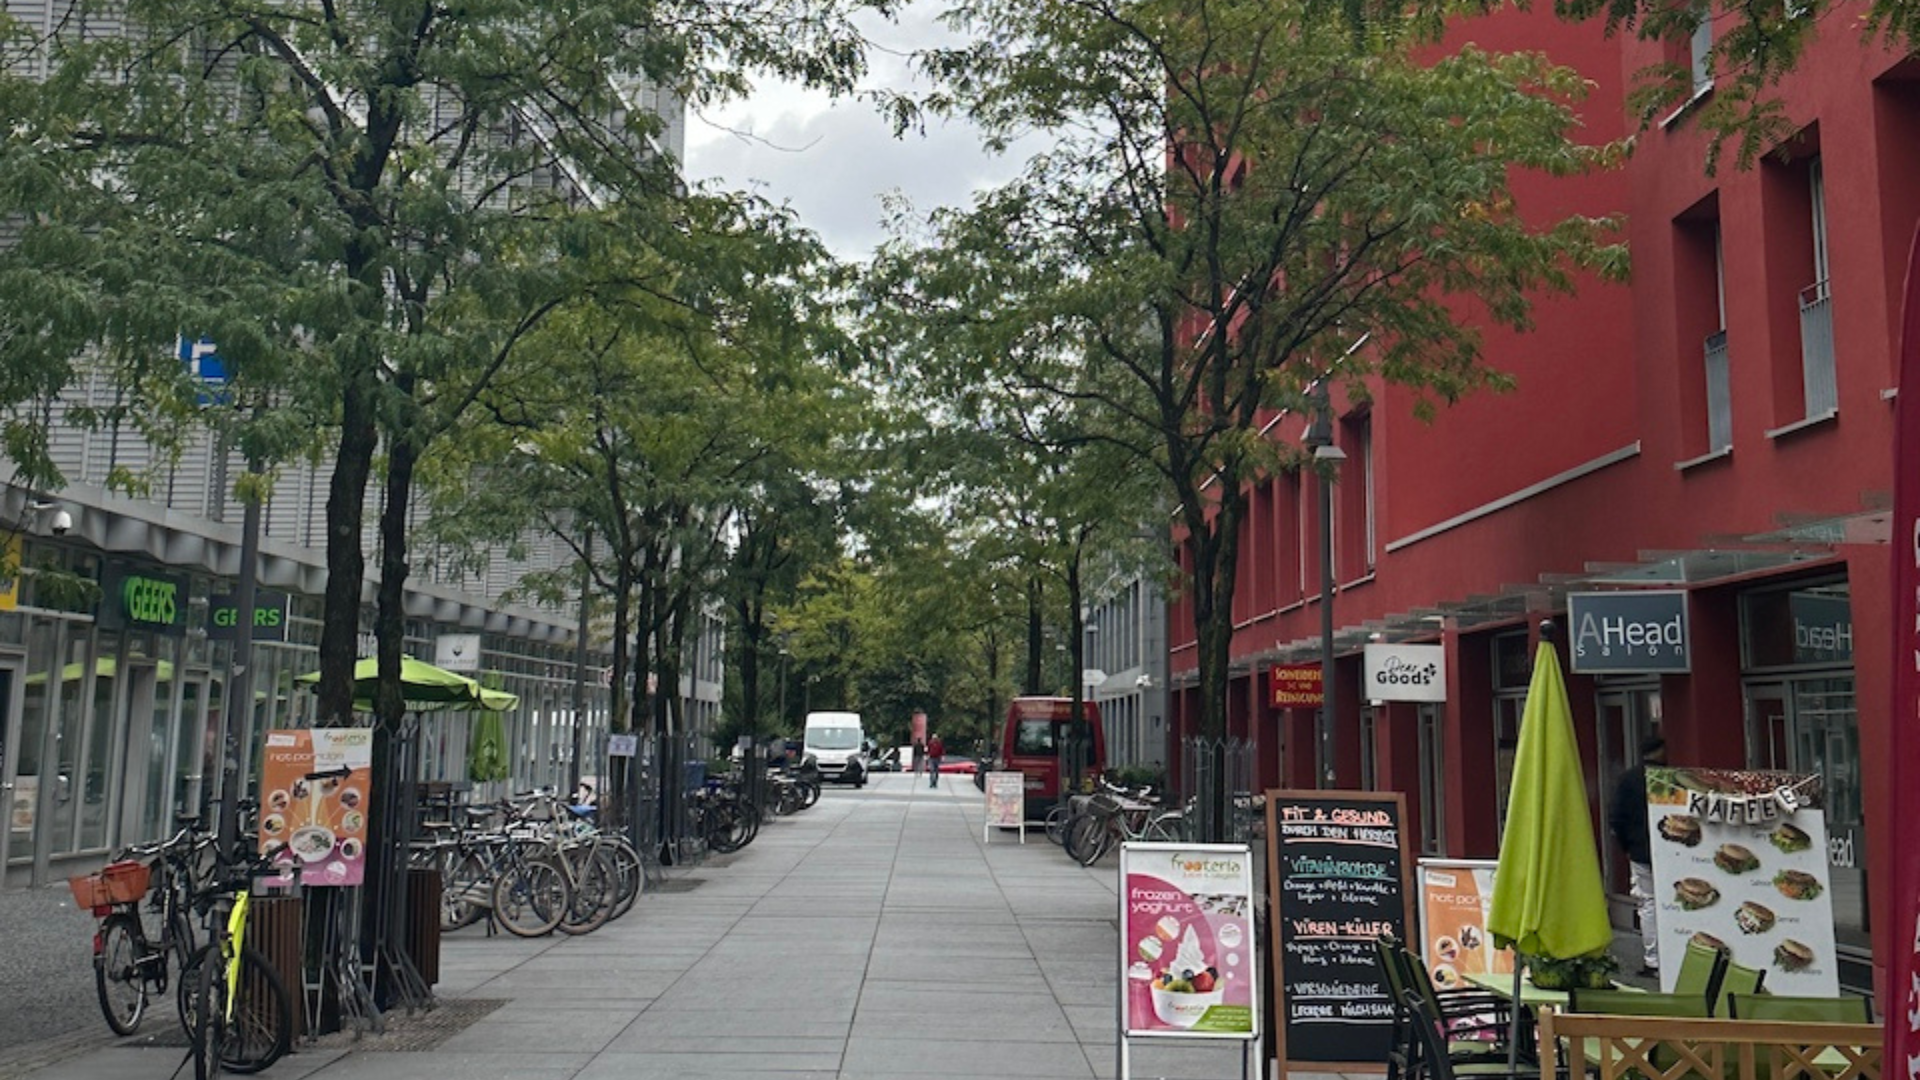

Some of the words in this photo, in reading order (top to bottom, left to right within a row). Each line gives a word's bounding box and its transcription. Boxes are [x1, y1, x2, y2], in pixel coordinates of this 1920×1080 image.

[128, 576, 176, 624] GEERS
[214, 608, 281, 627] GERS
[1384, 656, 1418, 673] Dear
[1376, 671, 1431, 685] Goods
[1689, 786, 1797, 821] KAFFEE
[1314, 808, 1328, 820] &
[1331, 809, 1391, 823] GESUND
[1827, 829, 1854, 867] ead
[1171, 853, 1241, 872] frooteria
[1131, 888, 1181, 900] frozen
[1429, 893, 1455, 903] hot
[1131, 901, 1193, 914] yoghurt
